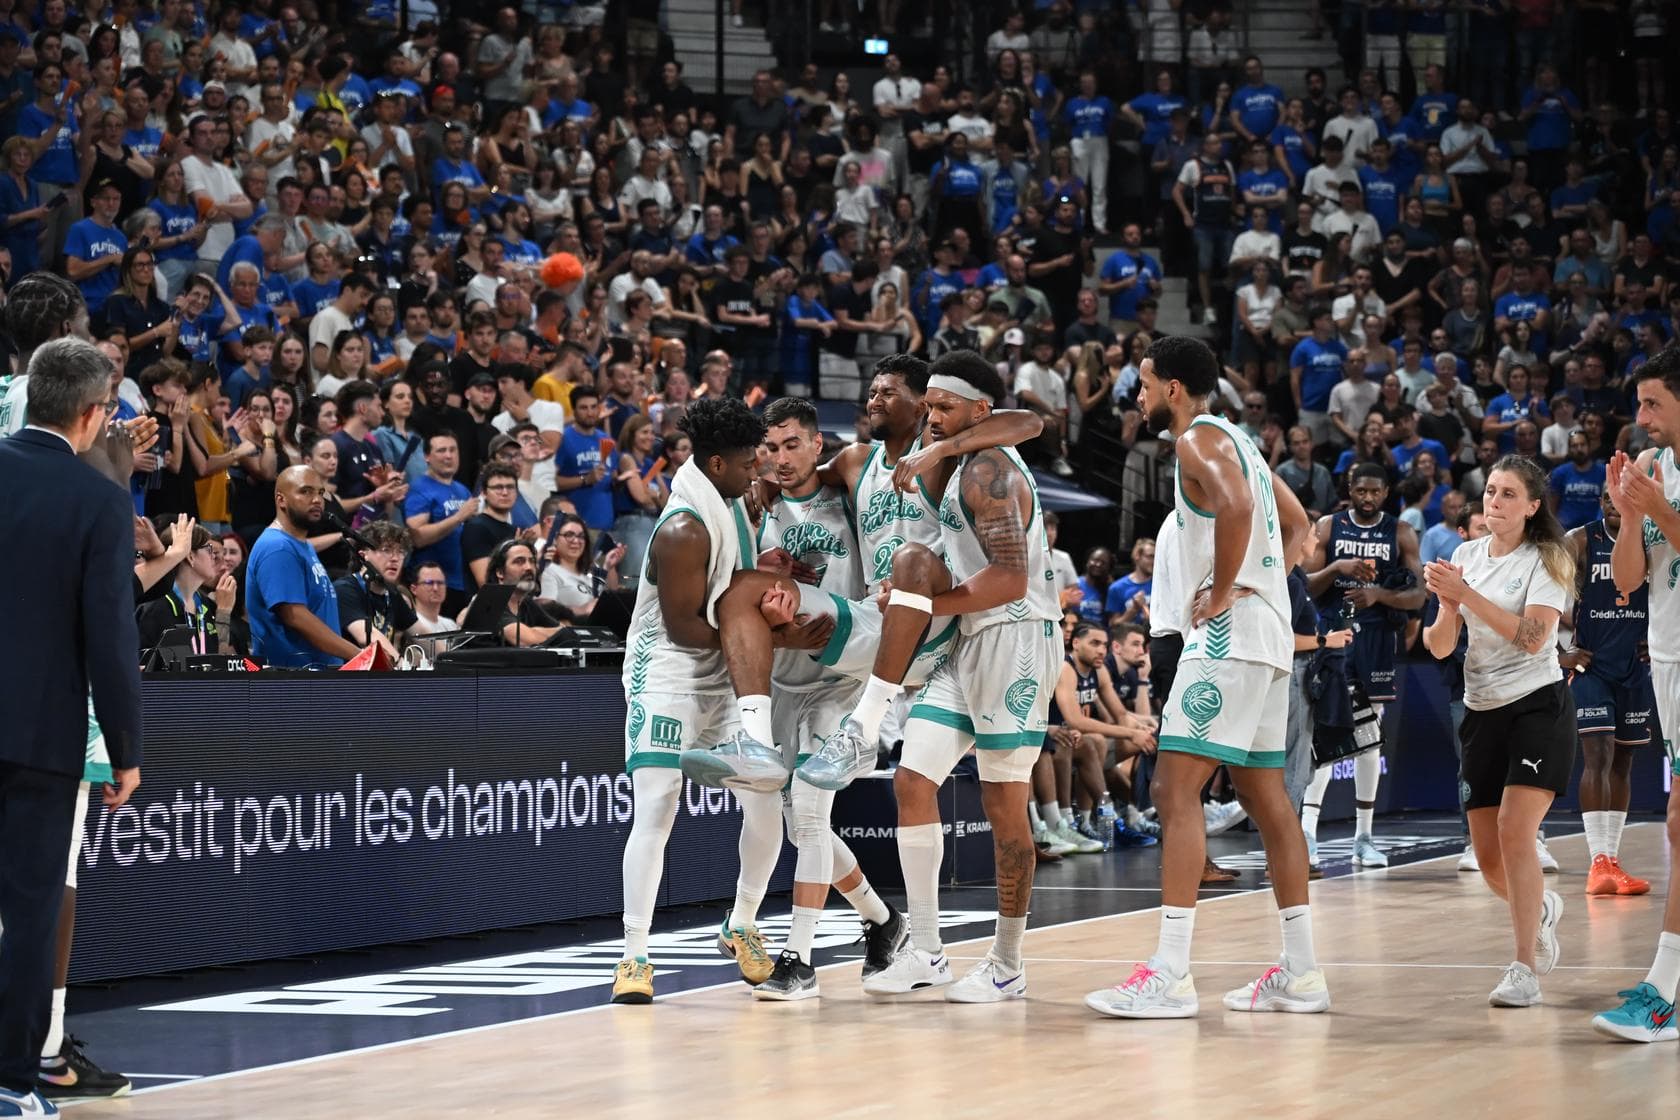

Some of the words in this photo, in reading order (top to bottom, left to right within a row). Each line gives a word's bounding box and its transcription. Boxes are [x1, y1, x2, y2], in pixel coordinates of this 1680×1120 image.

[1335, 539, 1391, 562] POITIERS
[1590, 609, 1615, 619] Crédit
[1625, 610, 1646, 619] Mutu
[233, 792, 347, 874] pour
[355, 772, 414, 847] les
[421, 761, 633, 846] champions
[839, 827, 899, 839] KRAM
